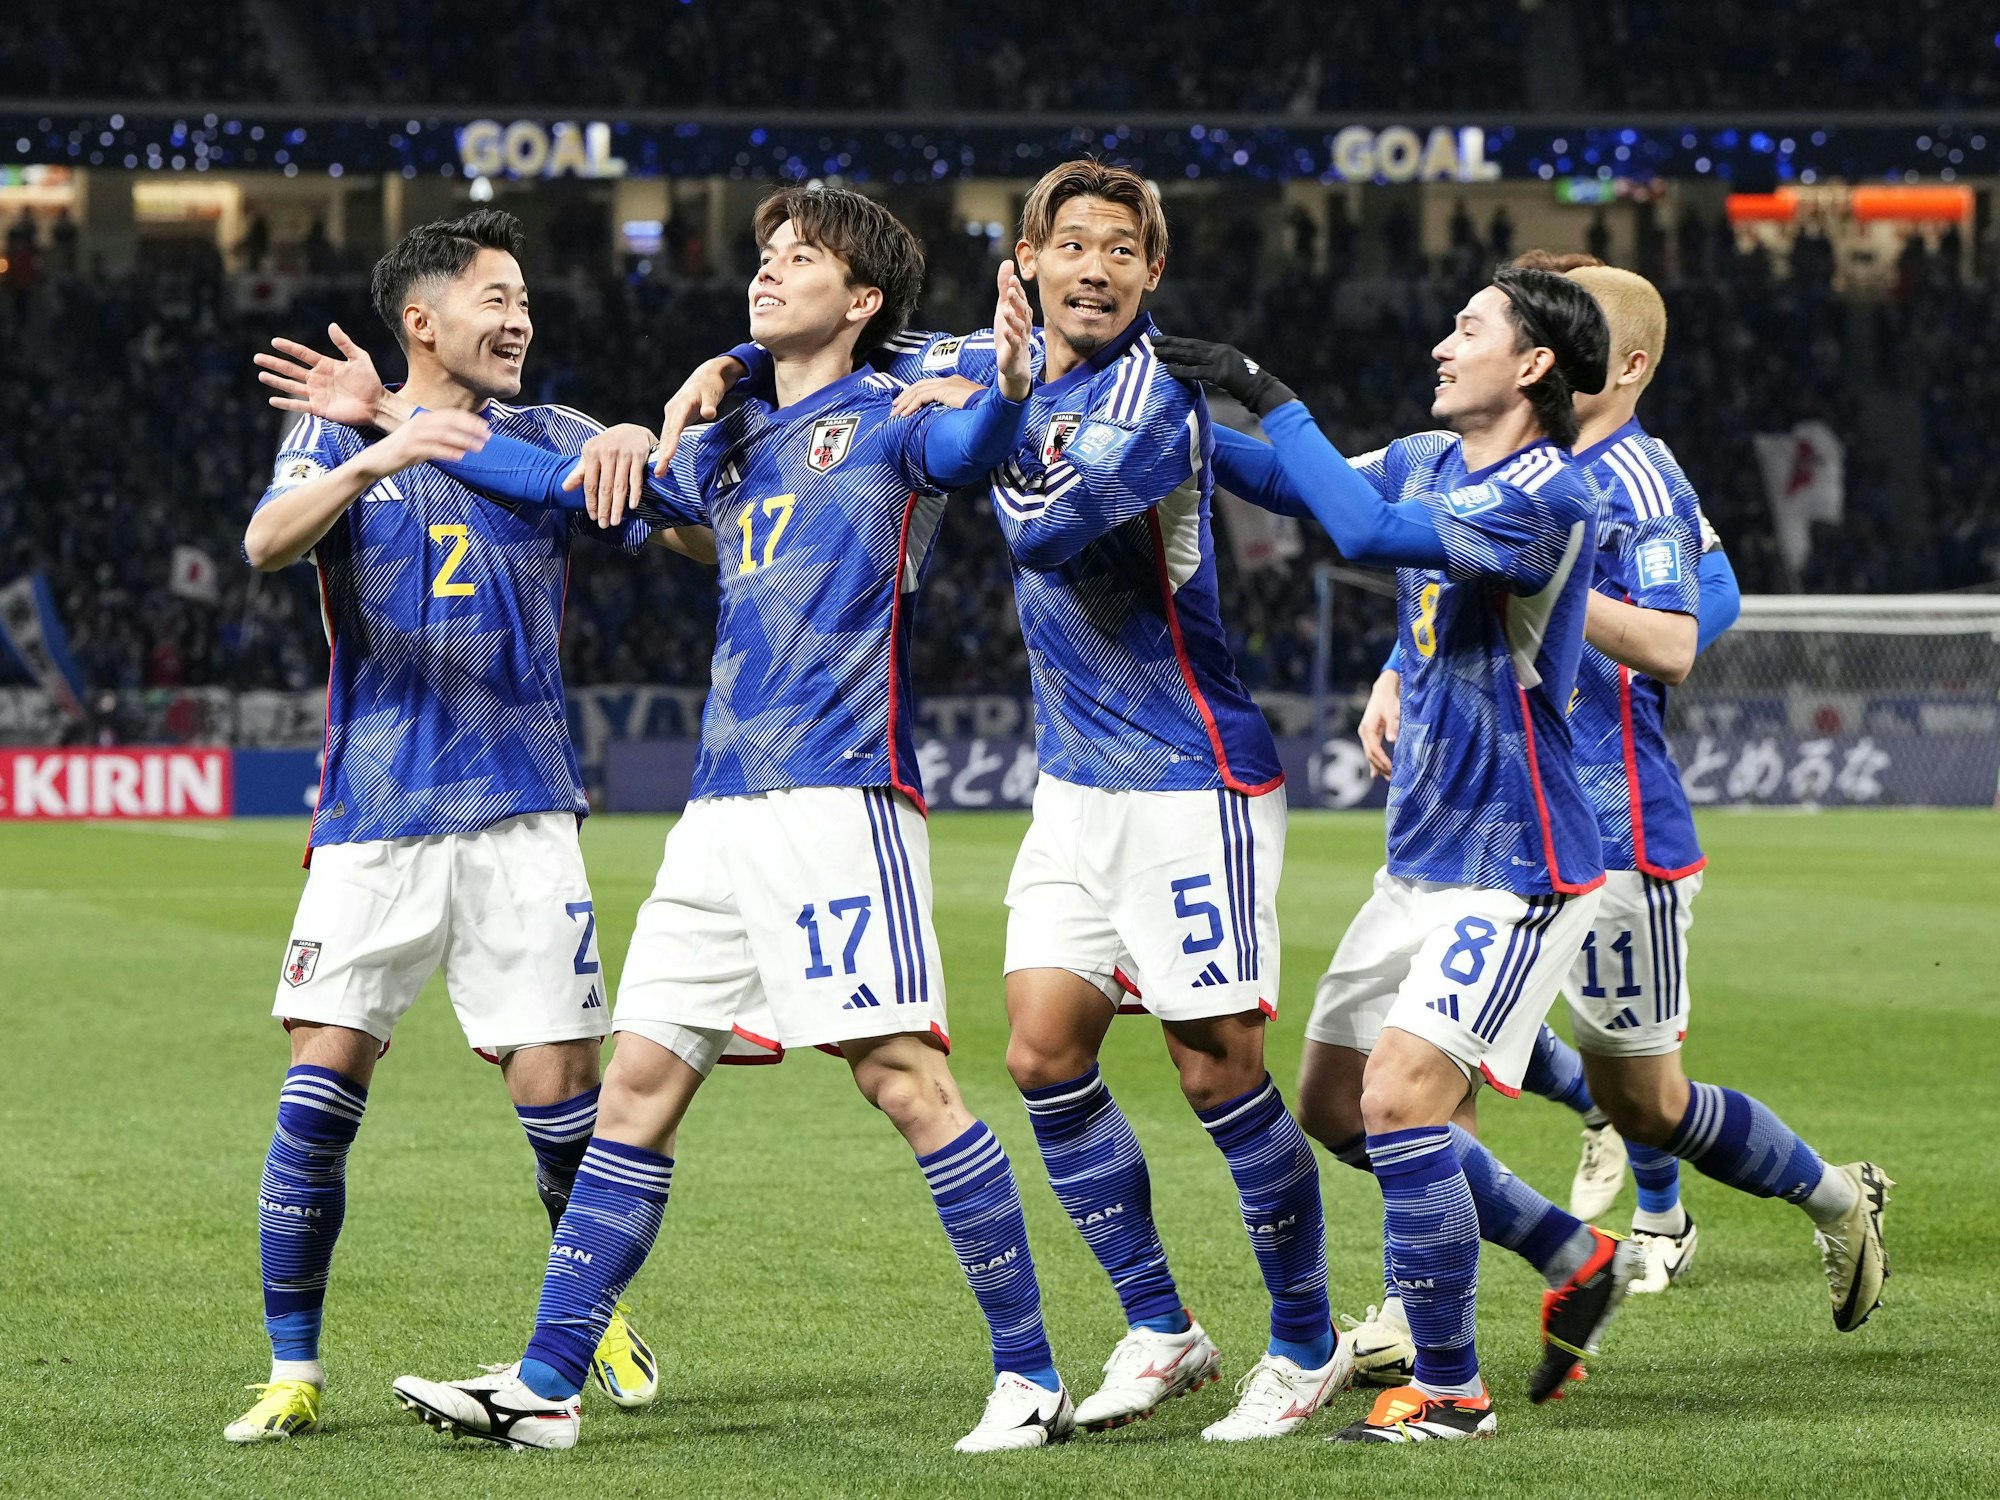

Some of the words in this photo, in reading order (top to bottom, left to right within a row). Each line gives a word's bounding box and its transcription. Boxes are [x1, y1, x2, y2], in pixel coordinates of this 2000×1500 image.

[461, 120, 627, 178] GOAL
[1332, 126, 1501, 182] GOAL
[430, 525, 475, 598] 2
[737, 493, 796, 575] 17
[1413, 583, 1439, 657] 8
[12, 753, 224, 816] KIRIN
[298, 940, 316, 948] JAPAN
[565, 901, 599, 975] 2
[796, 896, 872, 979] 17
[1172, 874, 1225, 955] 5
[1442, 916, 1497, 986] 8
[1581, 930, 1641, 998] 11
[257, 1196, 322, 1218] APAN
